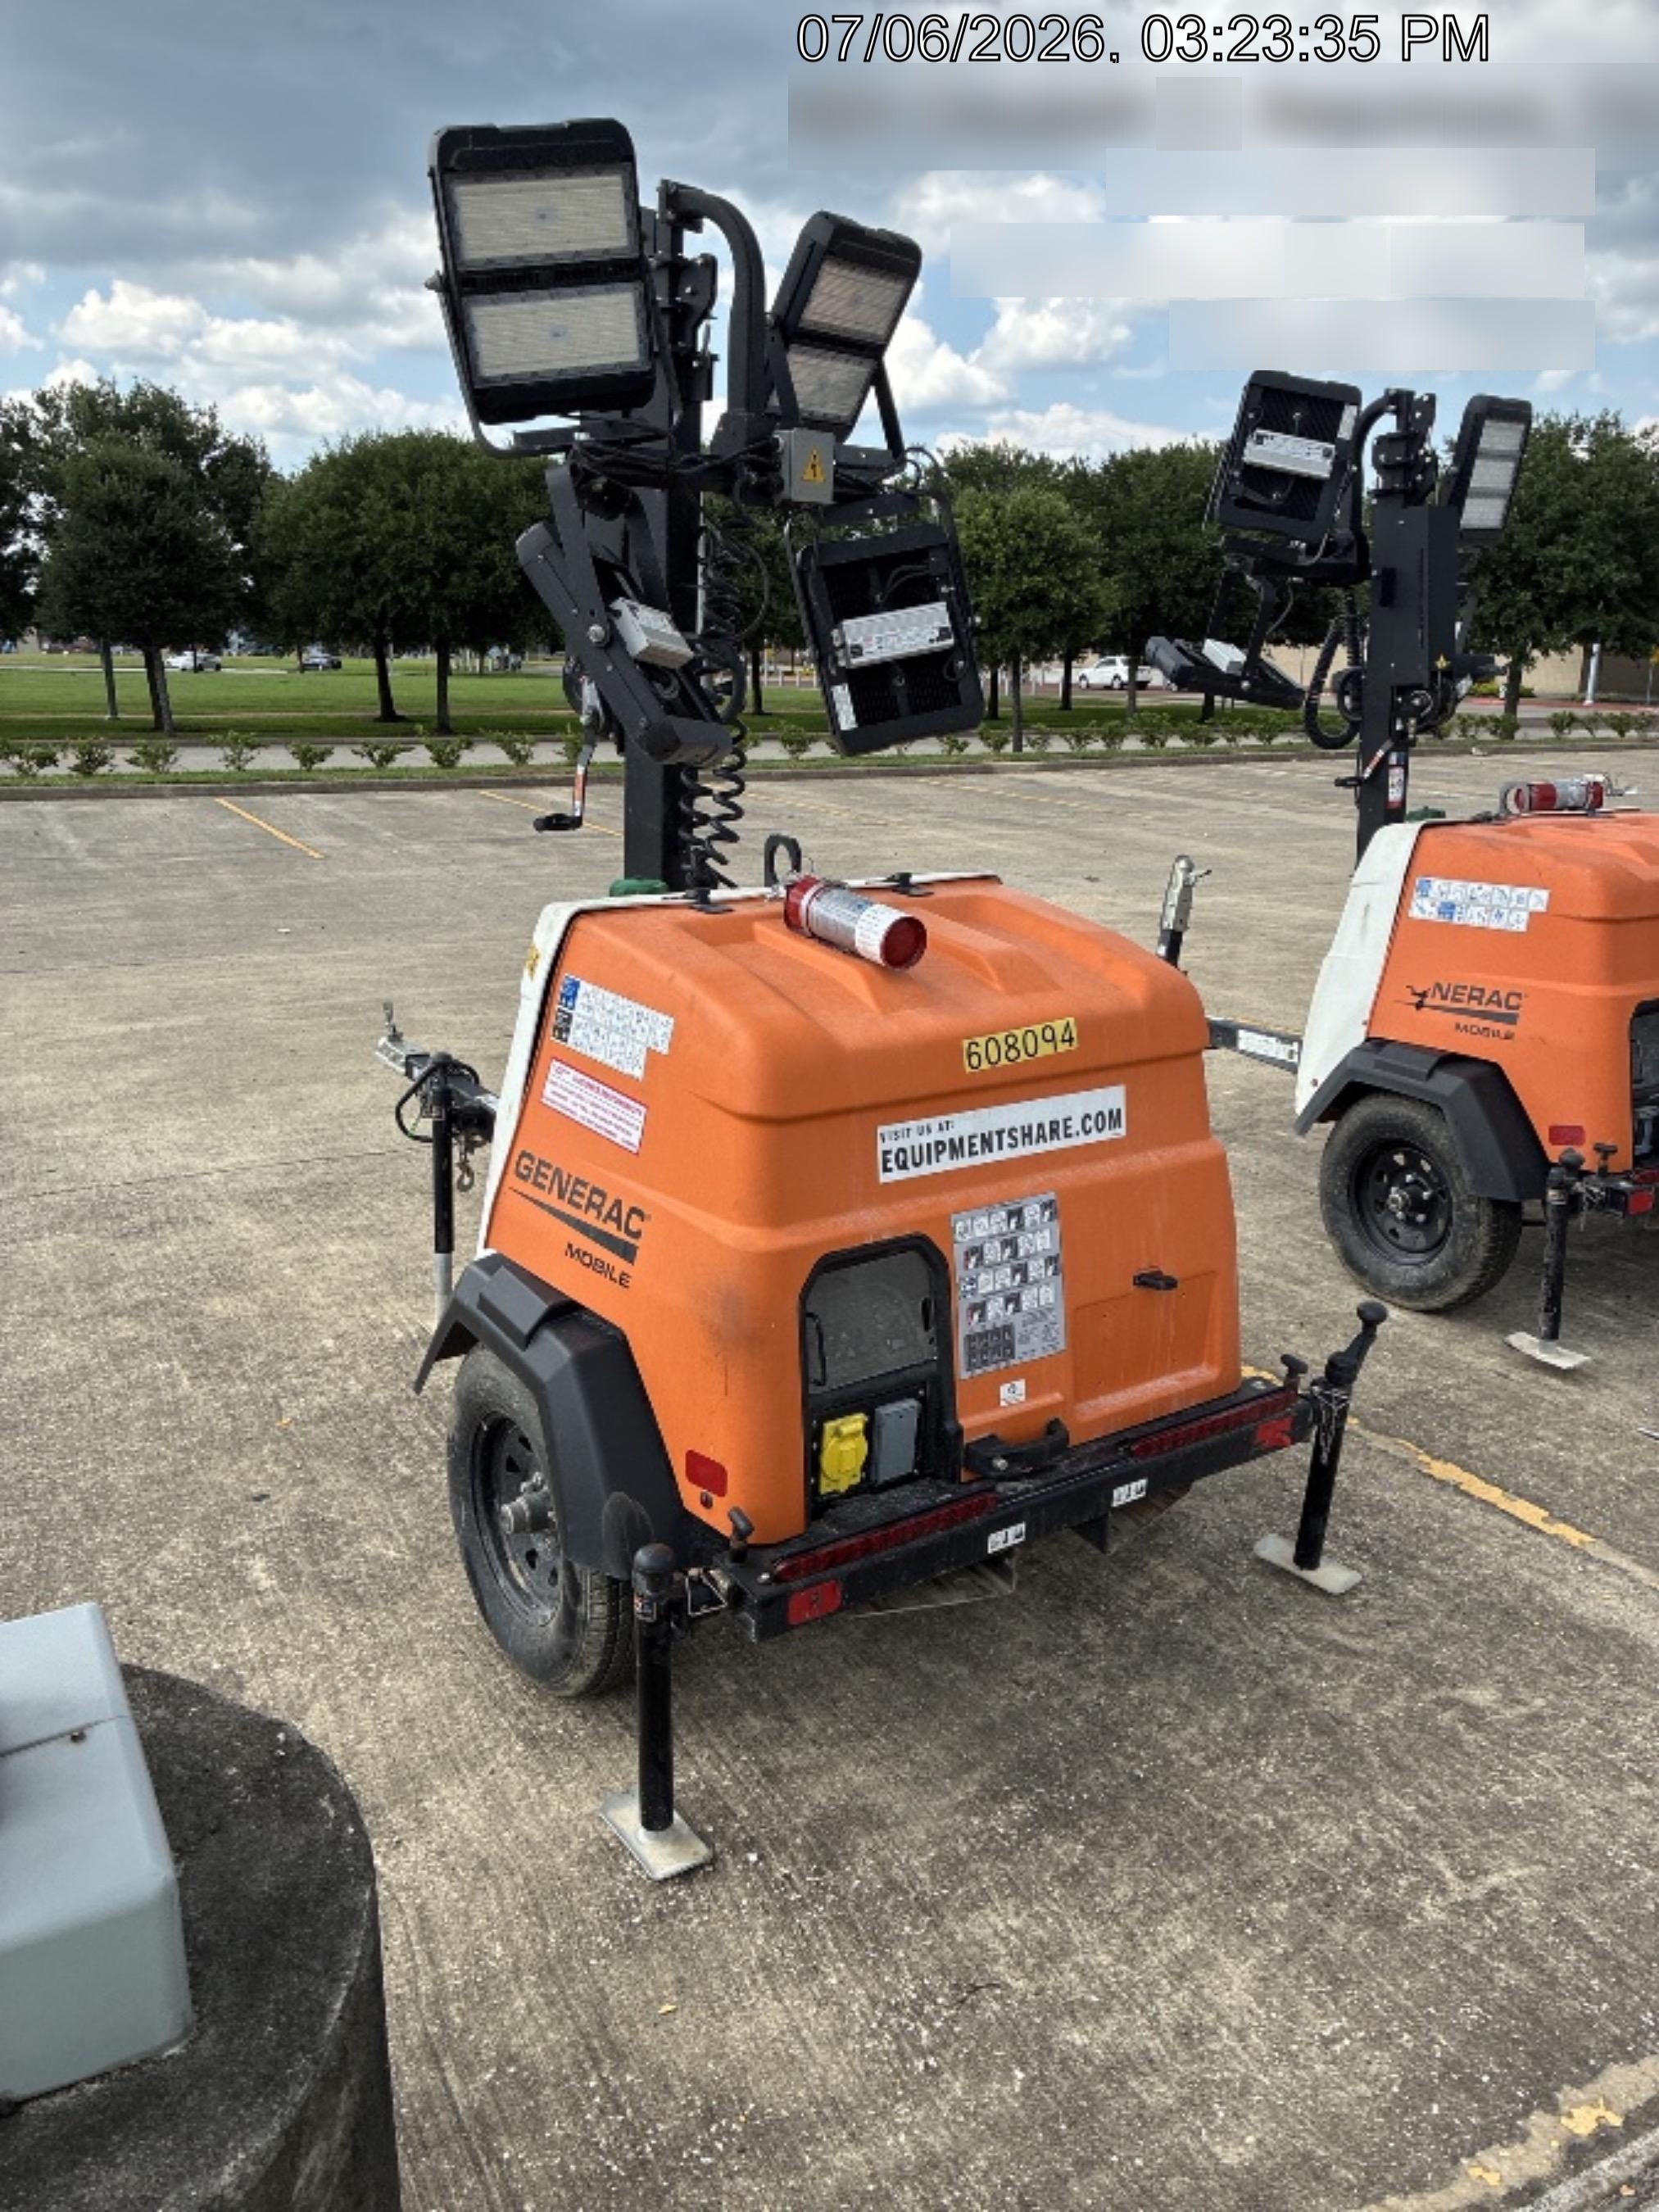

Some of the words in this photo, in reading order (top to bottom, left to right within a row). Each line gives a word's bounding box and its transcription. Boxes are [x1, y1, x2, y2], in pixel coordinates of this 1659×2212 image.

[966, 1019, 1075, 1070] 608094
[880, 1127, 911, 1144] VISIT
[917, 1123, 932, 1136] US
[882, 1108, 1122, 1173] EQUIPMENTSHARE.COM
[514, 1149, 646, 1240] GENERAC
[564, 1241, 632, 1289] MOBILE
